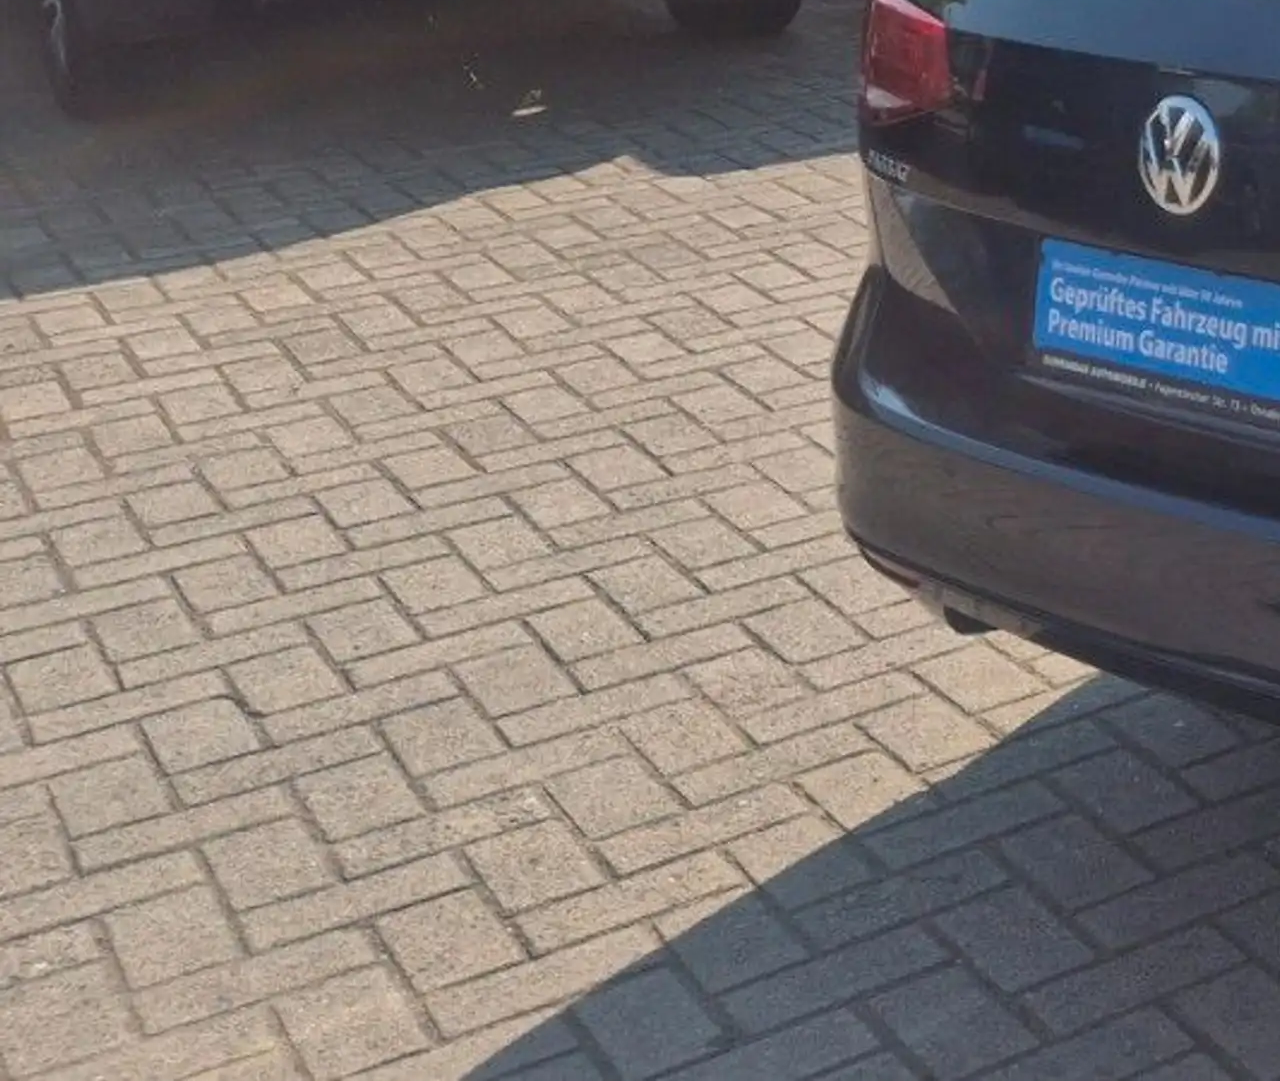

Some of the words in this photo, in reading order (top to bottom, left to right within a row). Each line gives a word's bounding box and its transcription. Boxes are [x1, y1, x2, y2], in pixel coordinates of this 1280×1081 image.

[1048, 308, 1135, 353] Premium
[1139, 329, 1229, 374] Garantie
[1051, 276, 1148, 321] Geprüftes
[1151, 296, 1248, 350] Fahrzeug
